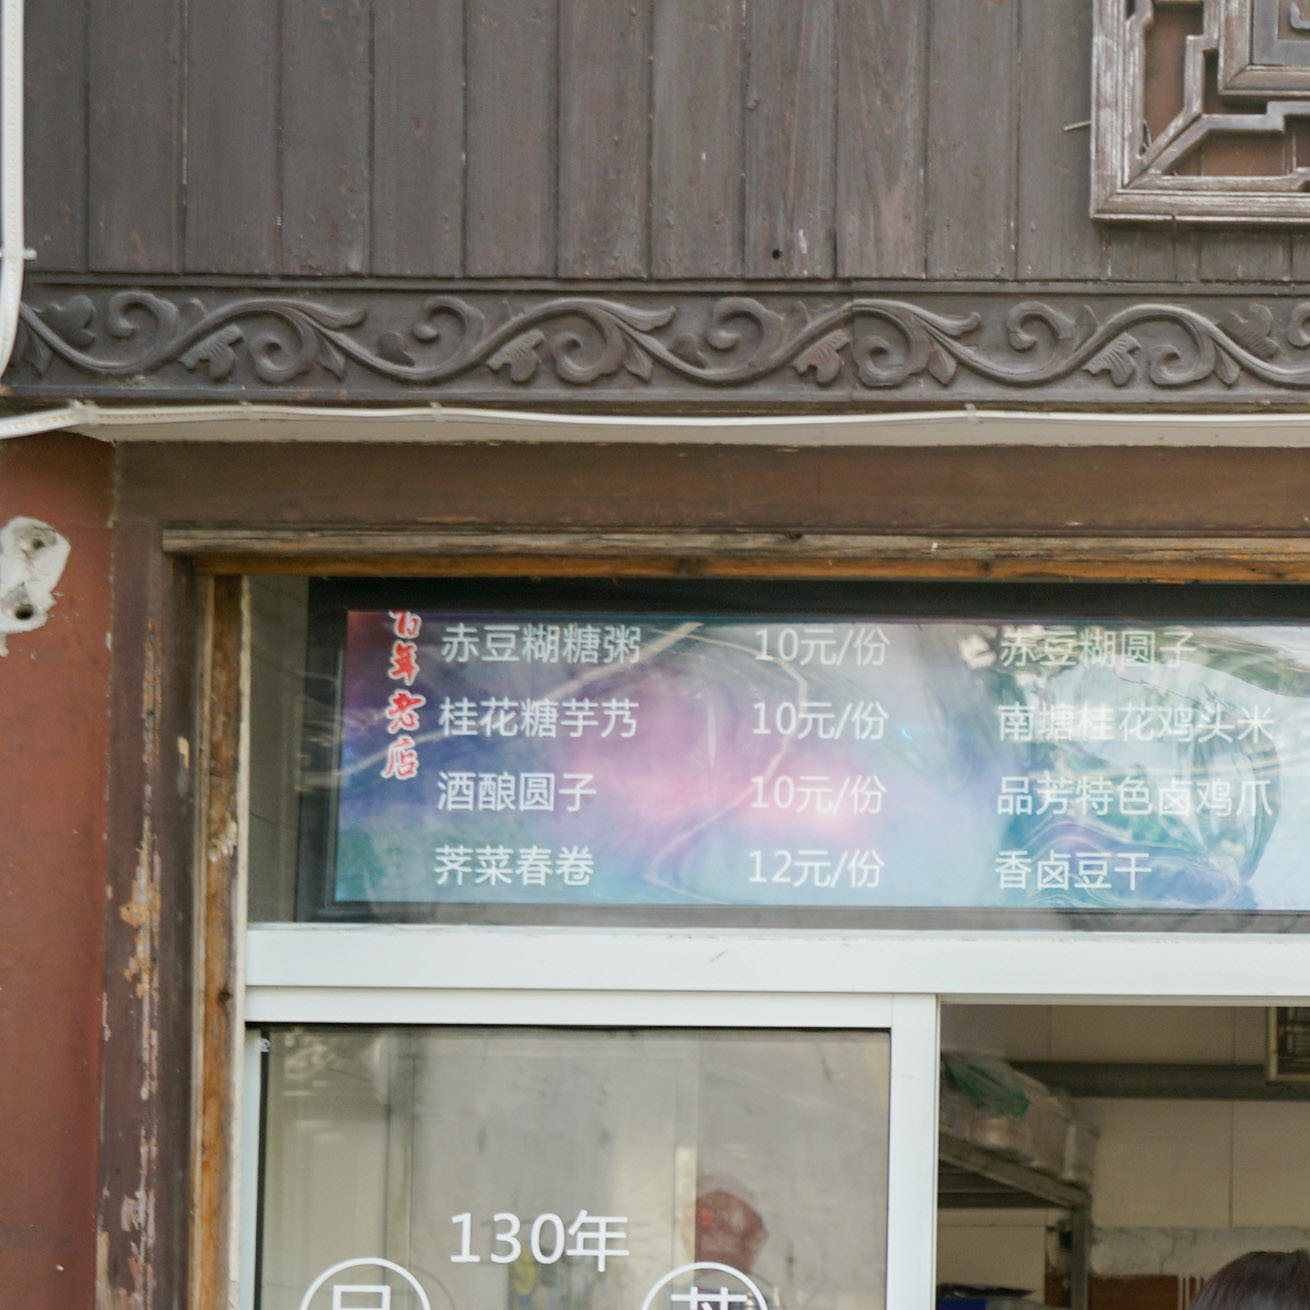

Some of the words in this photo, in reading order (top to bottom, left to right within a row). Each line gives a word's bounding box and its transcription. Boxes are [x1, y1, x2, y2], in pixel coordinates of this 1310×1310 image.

[440, 622, 642, 666] 赤豆糊糖粥
[755, 627, 890, 668] 10元/份
[381, 611, 426, 780] 百年老店
[438, 697, 639, 741] 桂花糖芋艿
[752, 701, 889, 742] 10元/份
[436, 771, 597, 814] 酒酿圆子
[751, 774, 887, 816] 10元/份
[996, 778, 1273, 819] 品芳特色卤鸡爪
[434, 845, 595, 888] 荠菜春卷
[748, 849, 885, 890] 12元/份
[994, 851, 1153, 893] 香卤豆干
[450, 1209, 630, 1273] 130年
